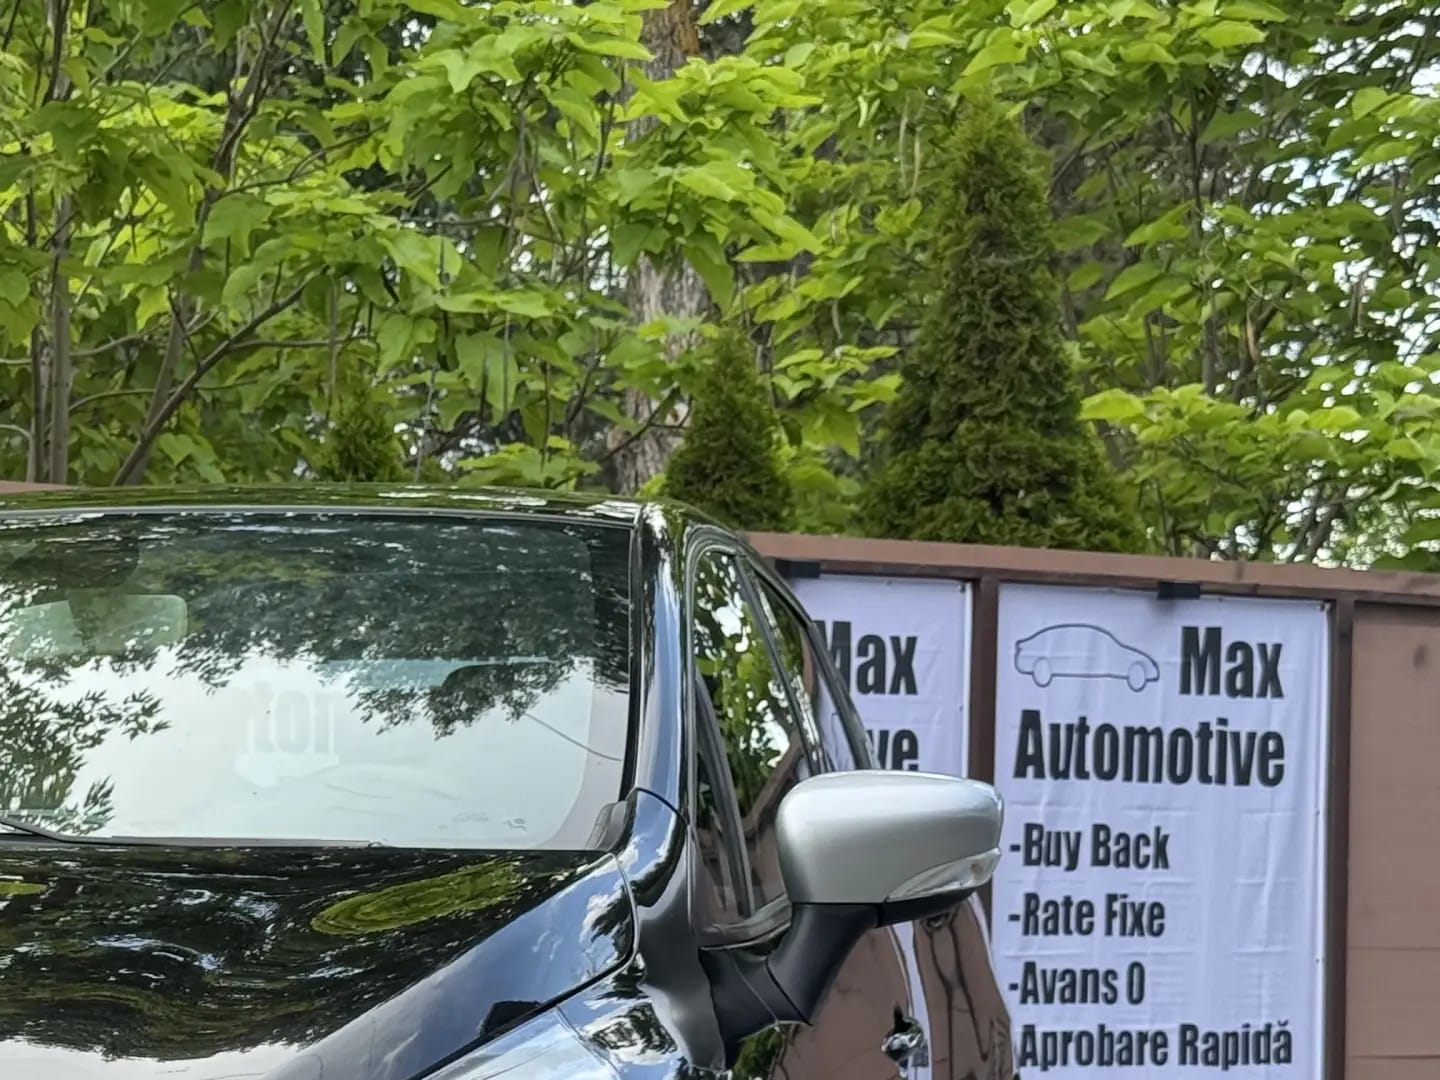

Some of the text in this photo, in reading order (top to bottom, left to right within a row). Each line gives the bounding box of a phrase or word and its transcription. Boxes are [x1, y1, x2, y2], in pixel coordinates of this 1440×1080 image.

[1180, 626, 1283, 698] Max
[1013, 709, 1285, 787] Automotive
[1009, 823, 1169, 871] -Buy Back
[1008, 893, 1165, 937] -Rate Fixe
[1008, 961, 1118, 1005] -Avans
[1178, 1019, 1293, 1071] Rapidă
